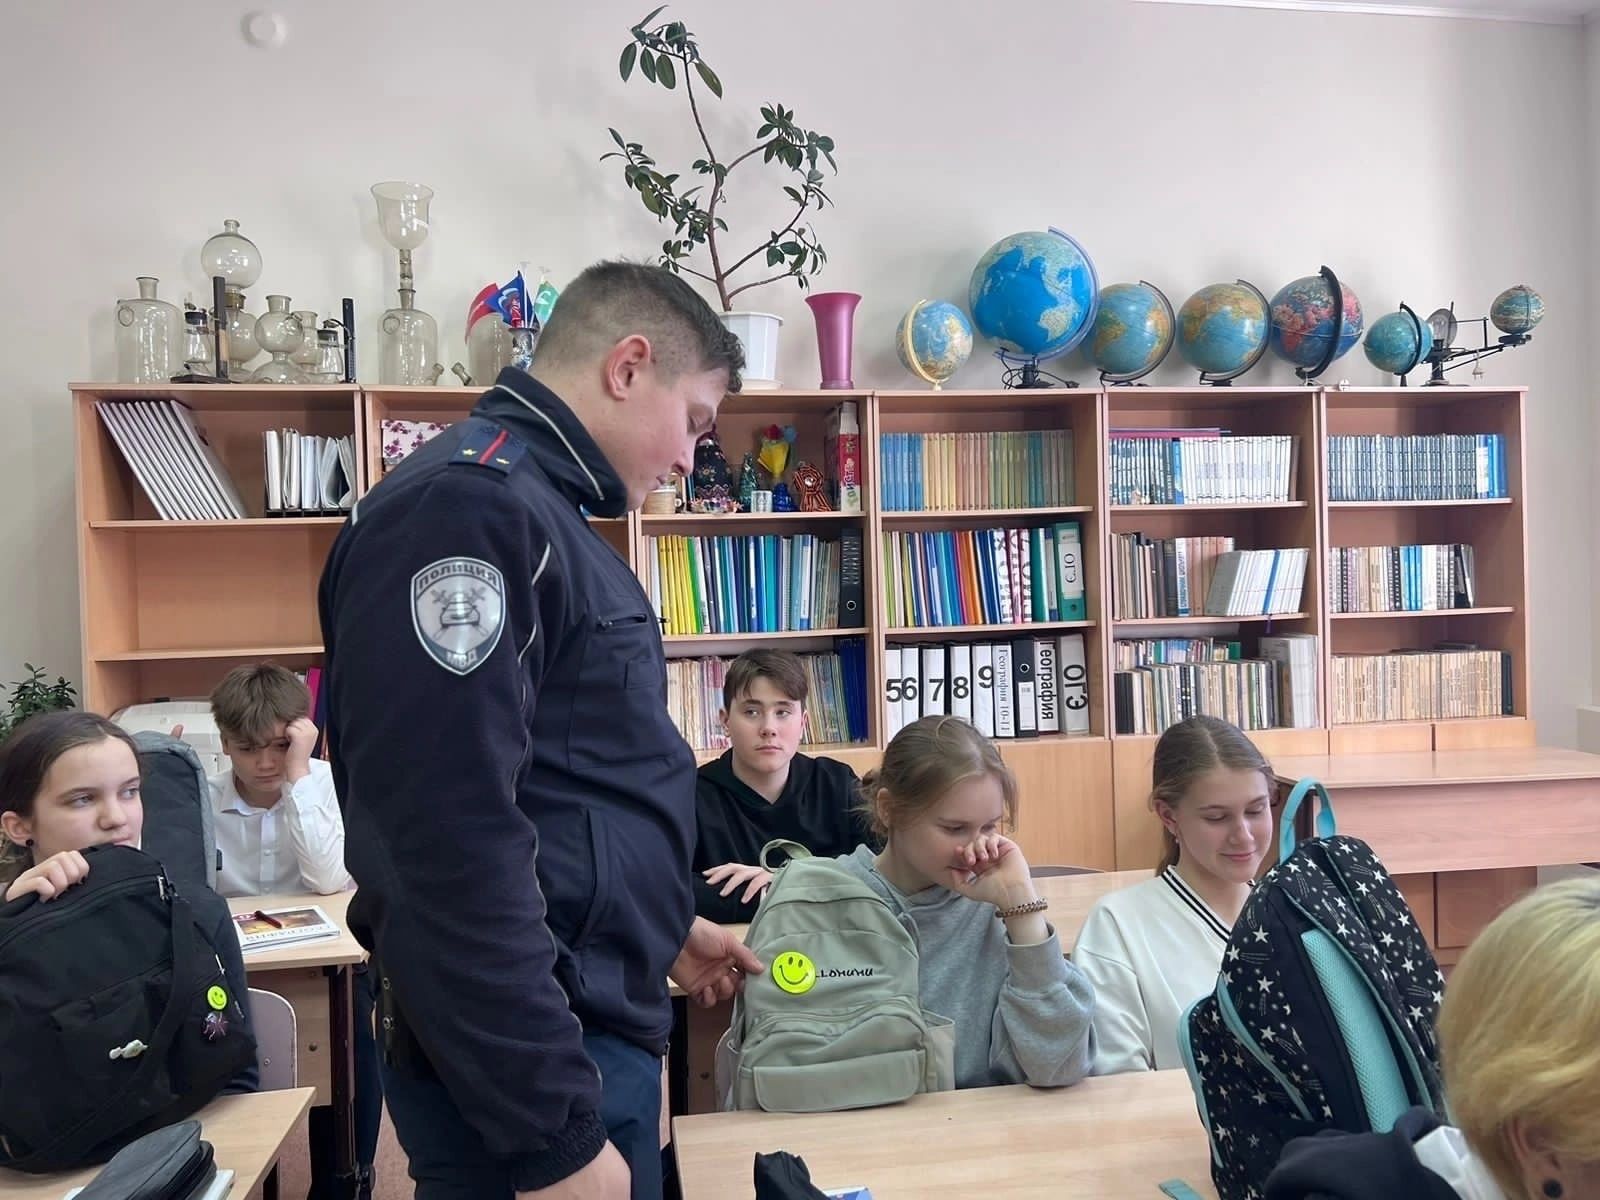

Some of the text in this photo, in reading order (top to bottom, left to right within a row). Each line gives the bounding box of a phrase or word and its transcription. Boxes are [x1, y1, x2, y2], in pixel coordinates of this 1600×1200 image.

[419, 563, 498, 590] ПОЛИЦИЯ
[902, 676, 918, 701] 6
[952, 676, 969, 699] 8
[977, 665, 993, 689] 9
[996, 648, 1010, 731] География 10-11
[1036, 641, 1057, 721] География
[1063, 664, 1088, 711] ОГЭ
[886, 678, 902, 702] 5
[928, 678, 944, 702] 7
